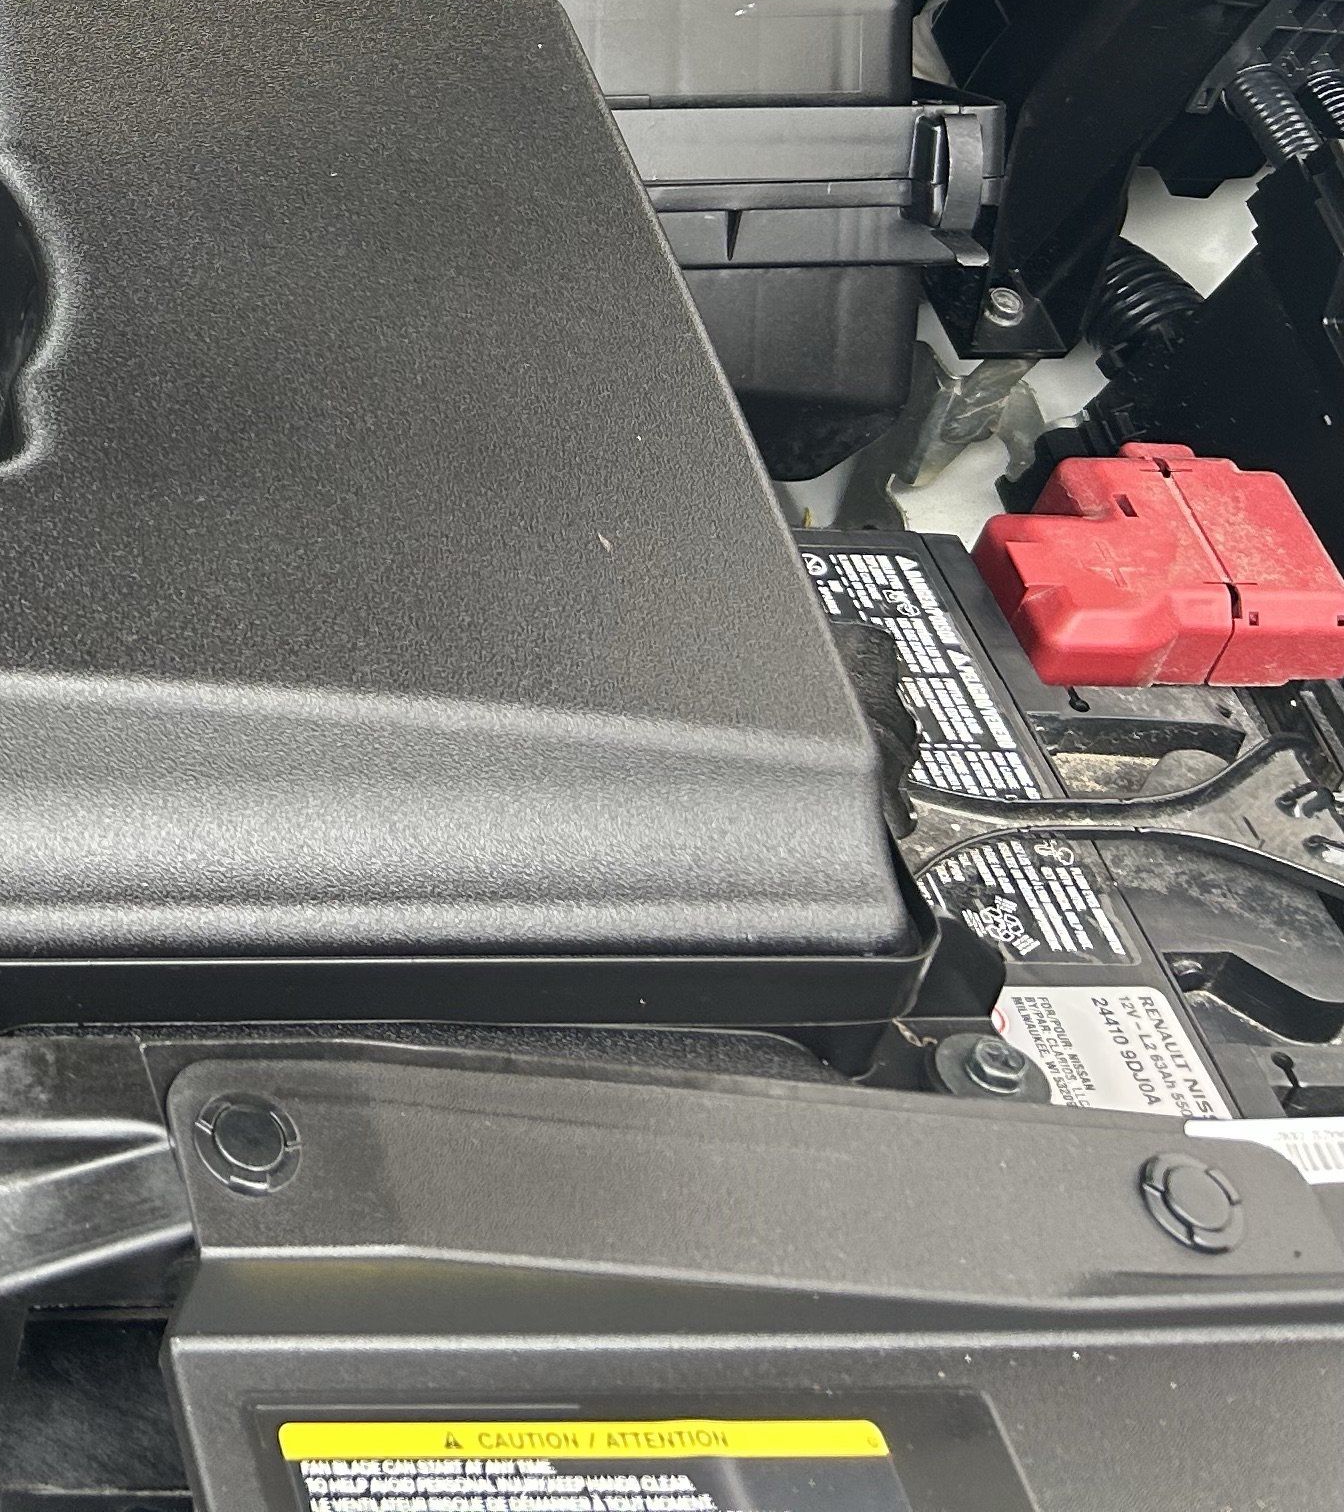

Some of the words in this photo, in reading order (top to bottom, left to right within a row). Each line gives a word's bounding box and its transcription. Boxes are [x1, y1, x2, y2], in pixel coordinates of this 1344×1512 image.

[1091, 996, 1129, 1045] 24410
[1121, 1050, 1162, 1105] 9DJ0A
[1119, 996, 1142, 1018] 12V
[1139, 1034, 1157, 1051] L2
[1151, 1054, 1177, 1089] 63Ah
[1138, 996, 1192, 1072] RENAULT
[1045, 1060, 1061, 1074] WI
[1067, 1053, 1097, 1091] NISSAN
[478, 1432, 579, 1450] CAUTION
[605, 1430, 729, 1449] ATTENTION
